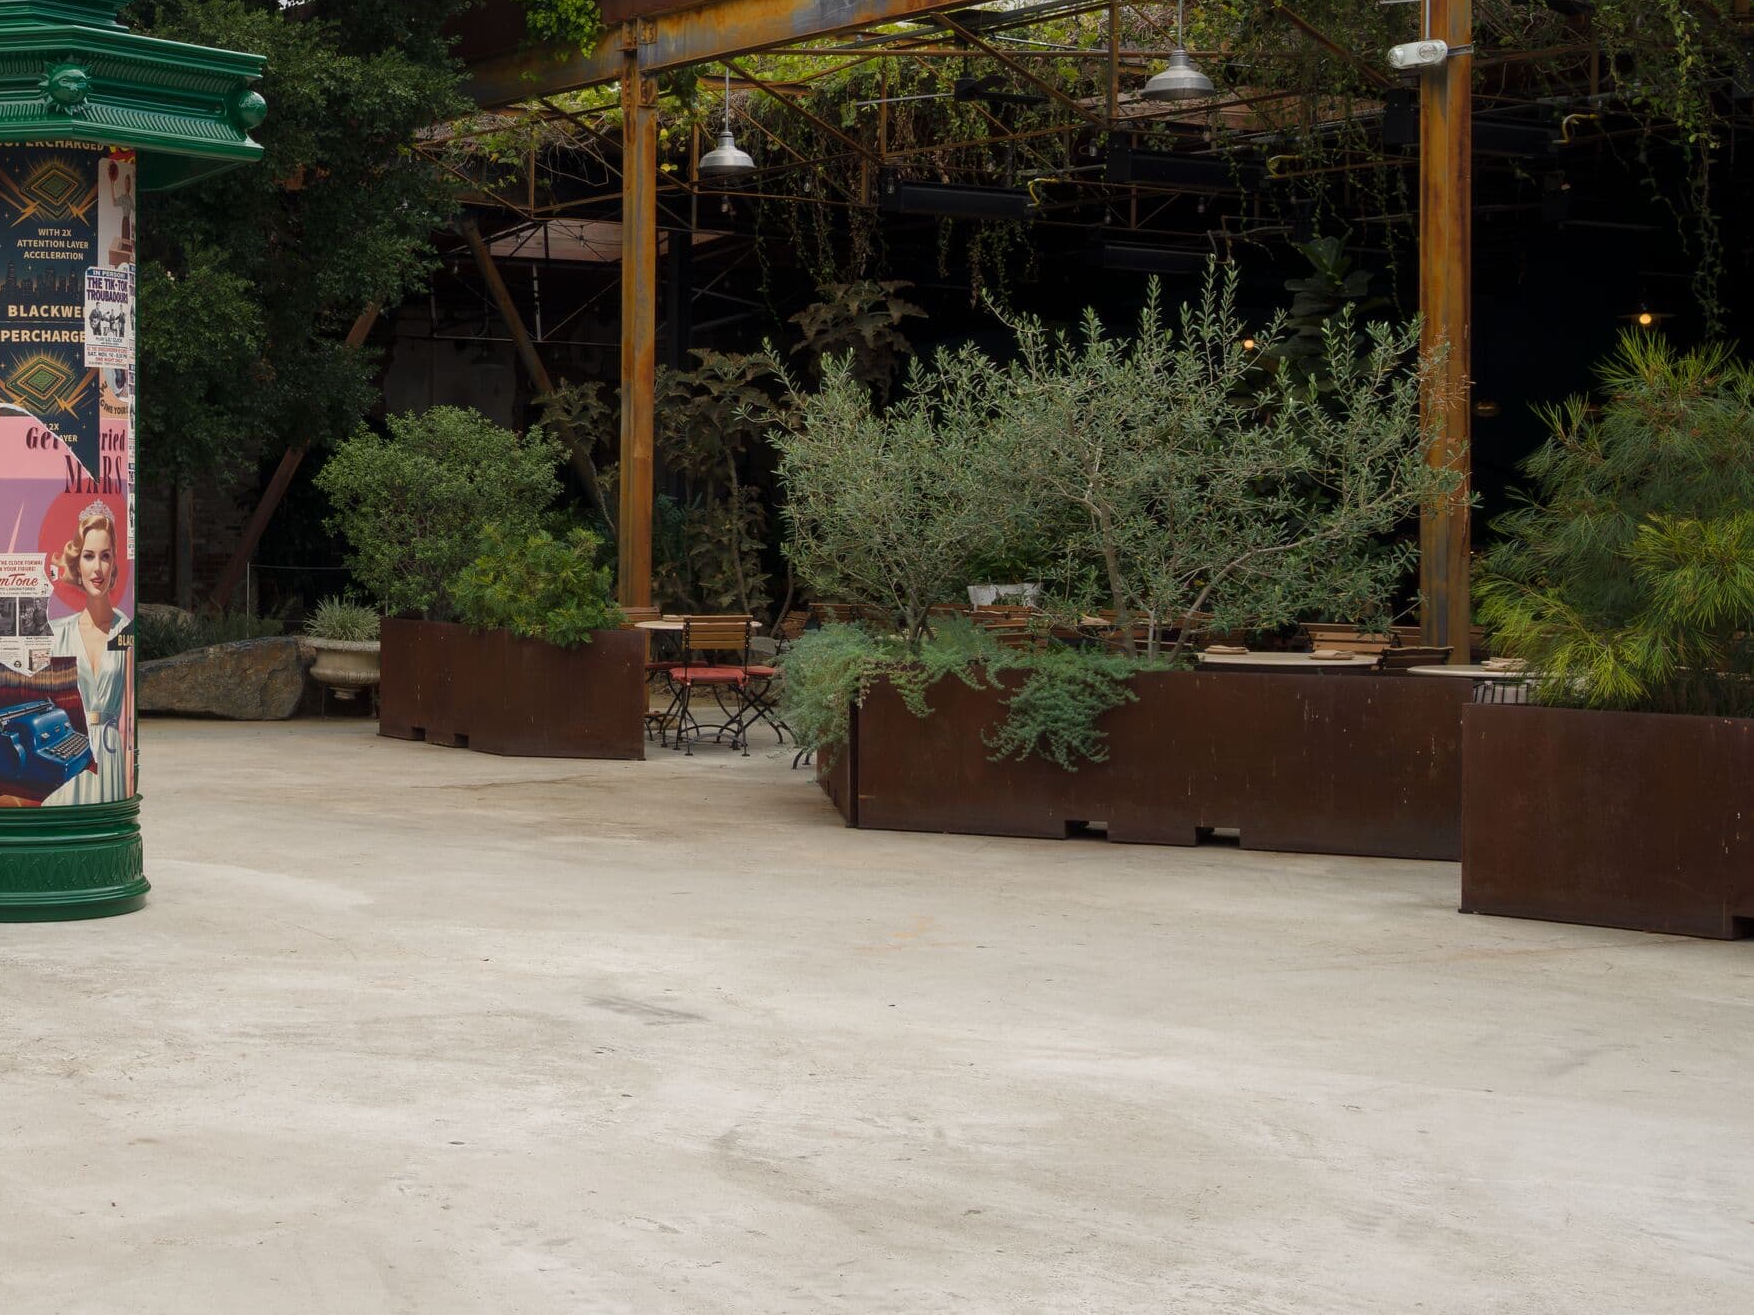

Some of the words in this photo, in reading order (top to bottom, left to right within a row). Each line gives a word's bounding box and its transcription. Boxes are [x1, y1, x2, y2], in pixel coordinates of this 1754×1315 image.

[38, 228, 59, 236] WITH
[62, 229, 72, 237] 2X
[17, 239, 65, 248] ATTENTION
[66, 241, 89, 249] LAYER
[23, 251, 84, 260] ACCELERATION
[87, 277, 103, 290] THE
[86, 289, 128, 304] TROUBADOURS
[8, 305, 85, 318] BLACKWE
[49, 423, 59, 431] 2X
[58, 434, 78, 442] AYER
[100, 429, 126, 452] ried
